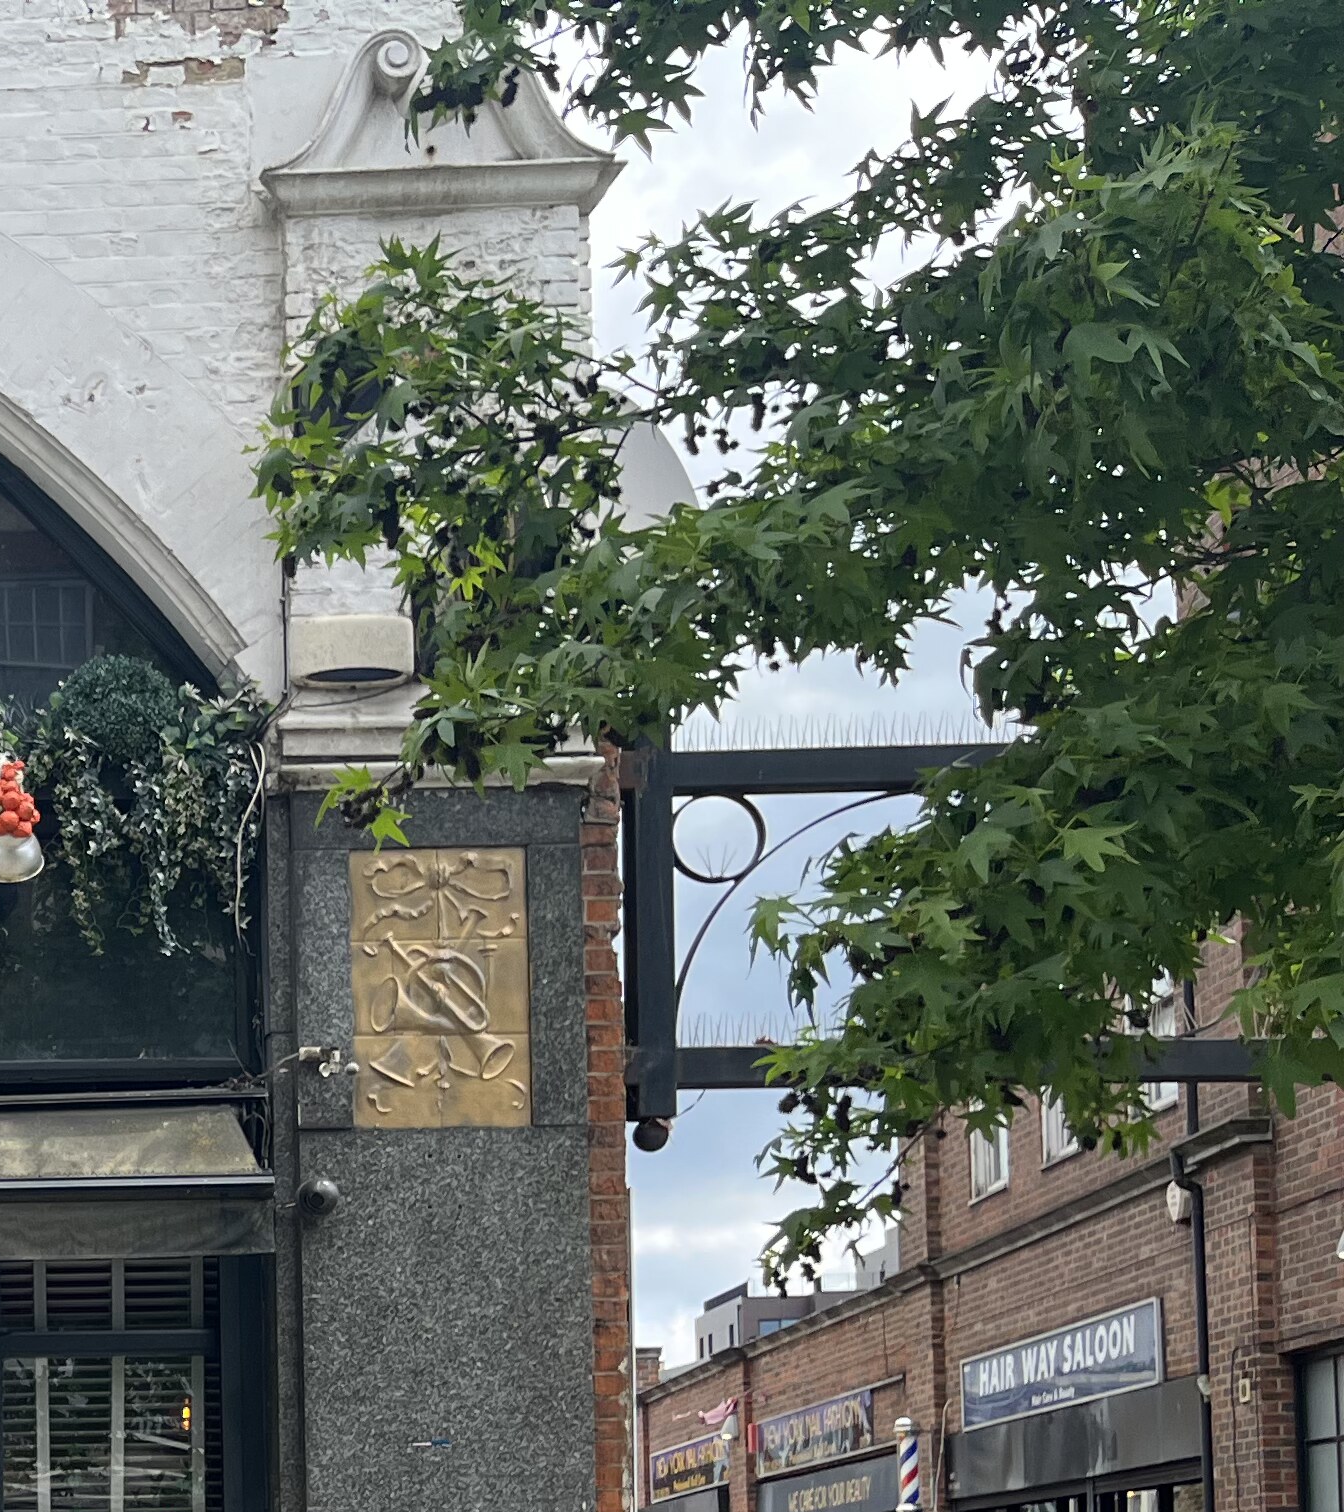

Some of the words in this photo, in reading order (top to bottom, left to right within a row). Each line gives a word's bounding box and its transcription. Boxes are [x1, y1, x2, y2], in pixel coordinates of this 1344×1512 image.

[978, 1355, 1015, 1397] HAIR
[1021, 1339, 1059, 1385] WAY
[1061, 1314, 1136, 1375] SALOON
